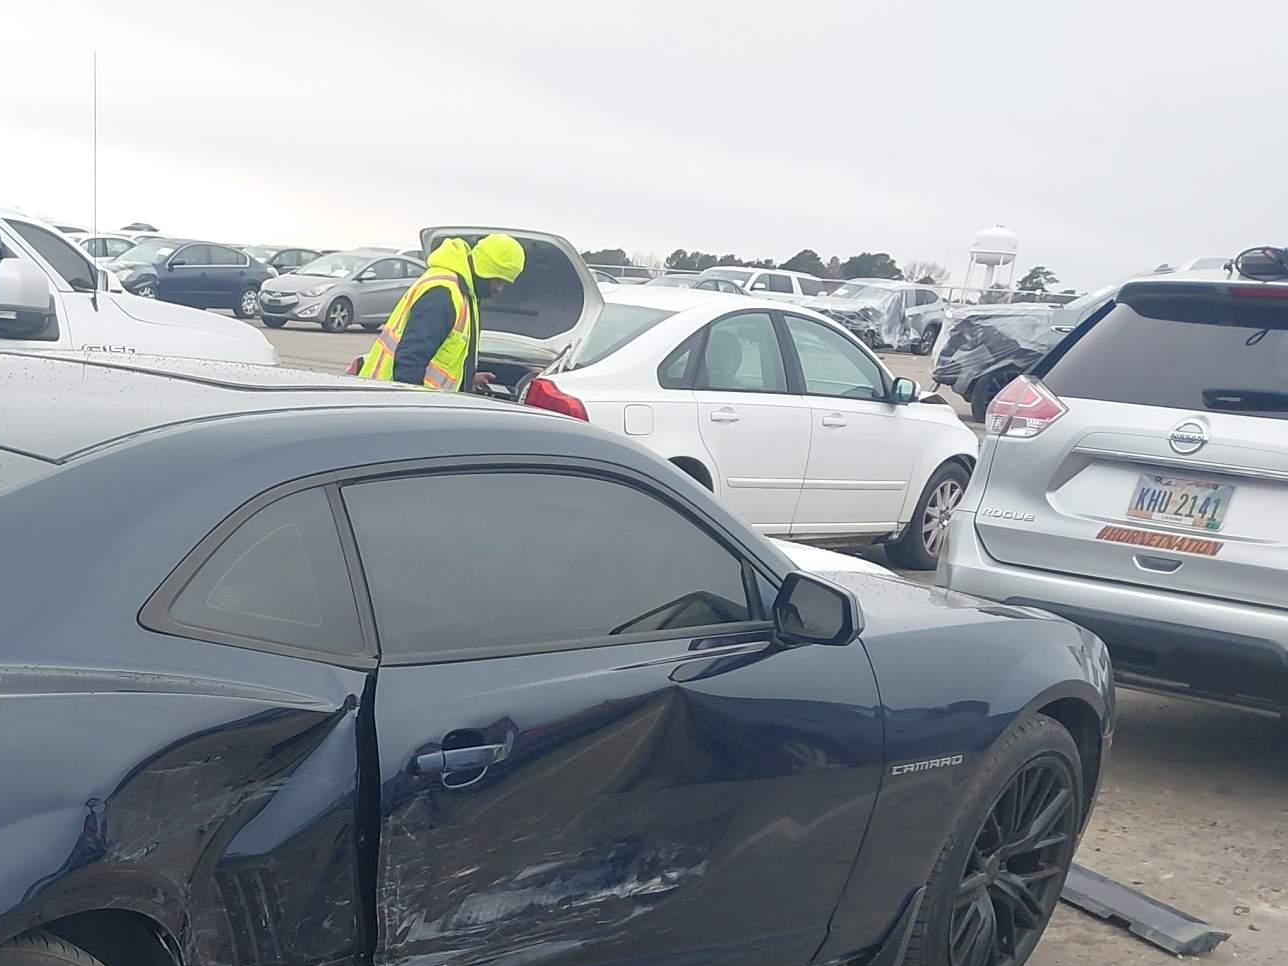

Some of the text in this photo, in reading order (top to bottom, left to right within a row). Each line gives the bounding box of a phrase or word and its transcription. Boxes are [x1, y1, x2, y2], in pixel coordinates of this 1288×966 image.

[982, 507, 1036, 522] ROGUE
[1134, 487, 1222, 521] KHU 2141
[892, 754, 963, 776] CAMARO
